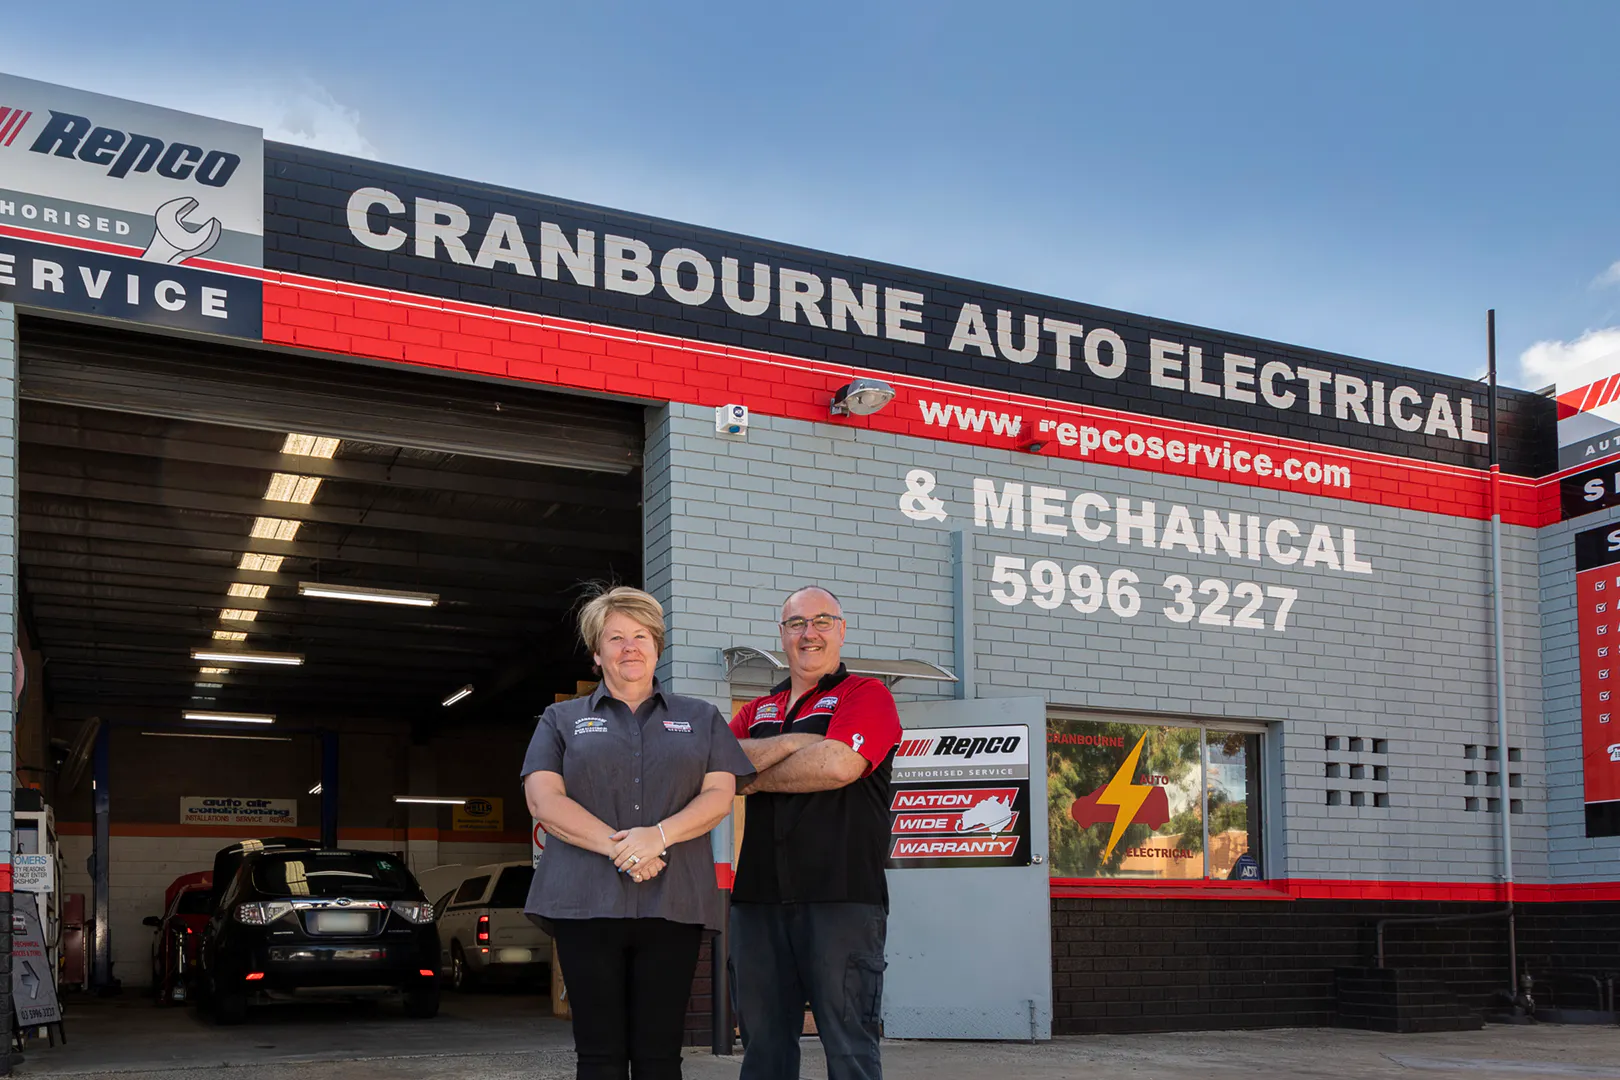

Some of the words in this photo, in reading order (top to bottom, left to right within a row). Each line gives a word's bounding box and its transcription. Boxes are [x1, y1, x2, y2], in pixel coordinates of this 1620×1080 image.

[29, 109, 242, 188] Repco
[0, 200, 131, 236] HORISED
[346, 186, 927, 345] CRANBOURNE
[948, 302, 1127, 380] AUTO
[1150, 338, 1489, 445] ELECTRICAL
[899, 469, 948, 523] &
[973, 477, 1374, 575] MECHANICAL
[990, 555, 1142, 620] 5996
[1162, 573, 1299, 633] 3227
[933, 735, 1021, 759] Repco
[1046, 733, 1125, 748] CRANBOURNE
[896, 768, 964, 778] AUTHORISED
[968, 767, 1013, 776] SERVICE
[1139, 773, 1169, 786] AUTO
[202, 798, 242, 807] auto
[246, 799, 272, 808] air
[897, 794, 973, 807] NATION
[185, 814, 229, 822] INSTALLATIONS
[235, 815, 262, 823] SERVICE
[269, 816, 295, 824] REPAIRS
[899, 818, 949, 830] WIDE
[899, 841, 1013, 854] WARRANTY
[1125, 847, 1195, 860] ELECTRICAL
[14, 855, 47, 865] OMERS
[1241, 865, 1258, 878] ADT
[29, 1008, 42, 1019] 5996
[43, 1007, 55, 1017] 3227
